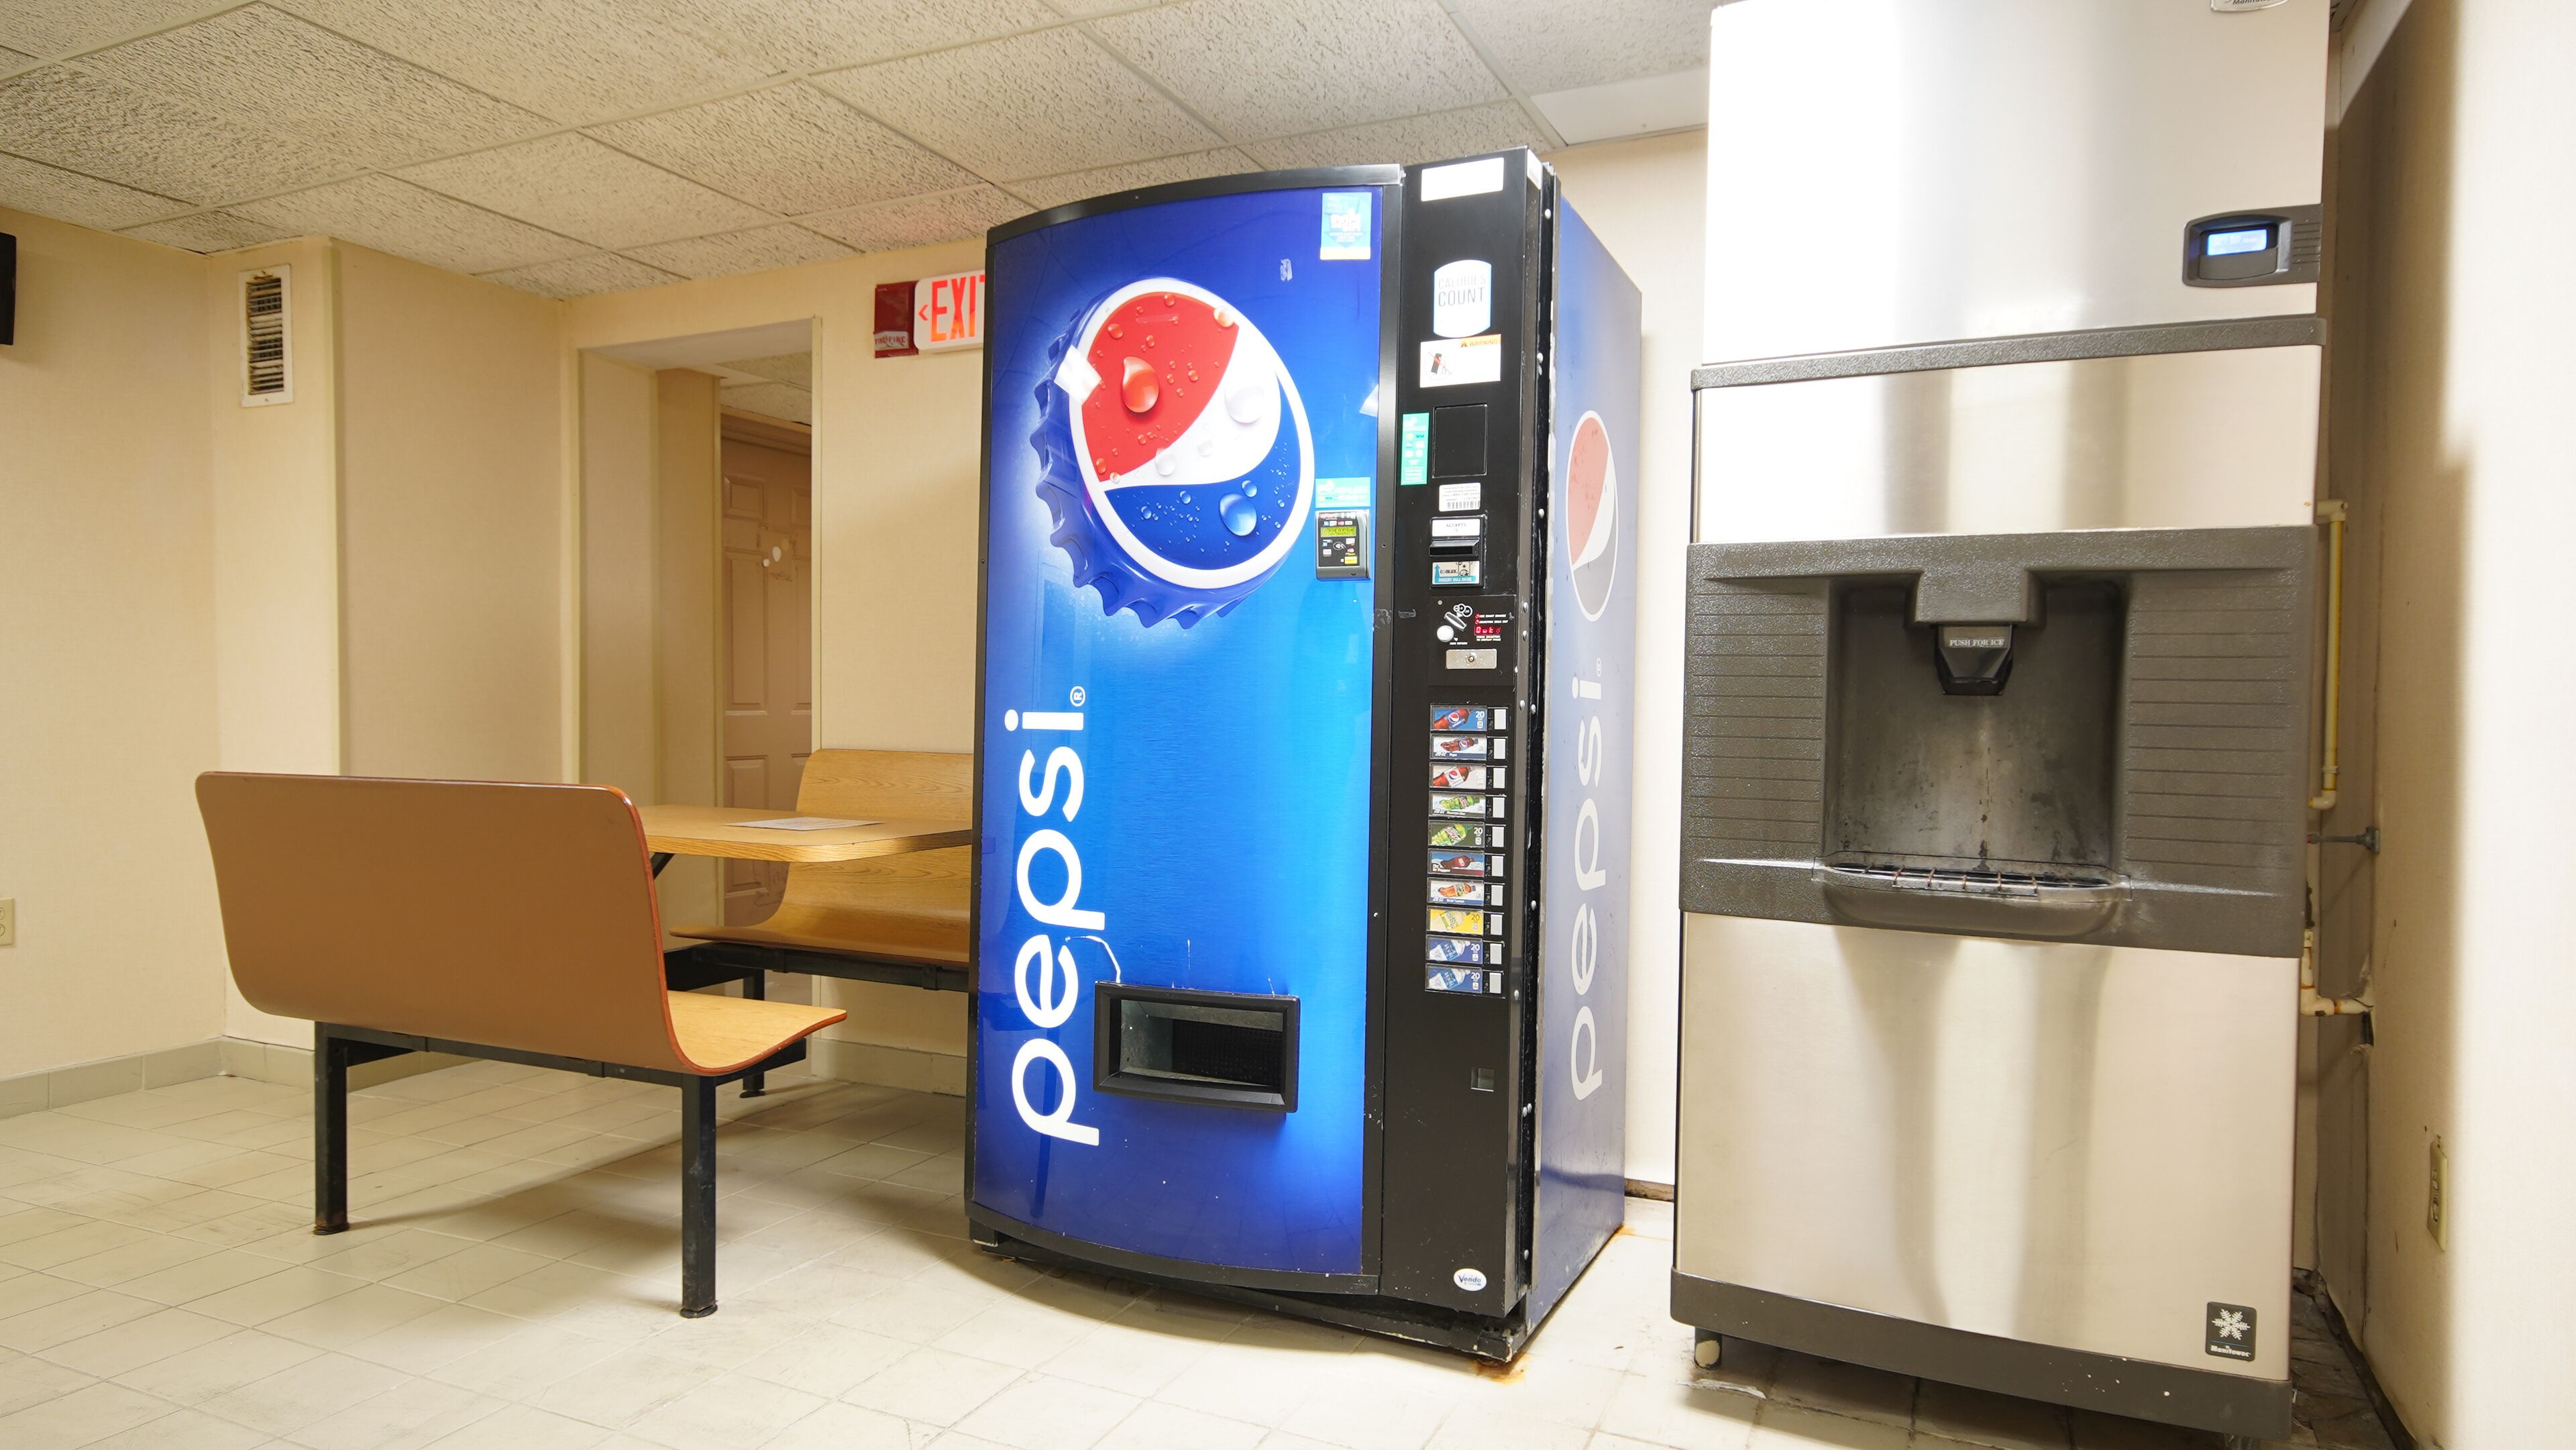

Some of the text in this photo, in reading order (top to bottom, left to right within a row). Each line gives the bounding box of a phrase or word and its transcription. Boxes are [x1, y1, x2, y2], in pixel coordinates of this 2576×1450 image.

[1438, 287, 1486, 307] COUNT
[1469, 338, 1499, 347] WARNING
[1972, 639, 1988, 648] FOR
[1990, 639, 2005, 647] ICE
[1470, 943, 1481, 951] 20
[1470, 972, 1481, 980] 20
[1458, 1274, 1481, 1283] Vendo
[2210, 1345, 2250, 1357] Manitowoc
